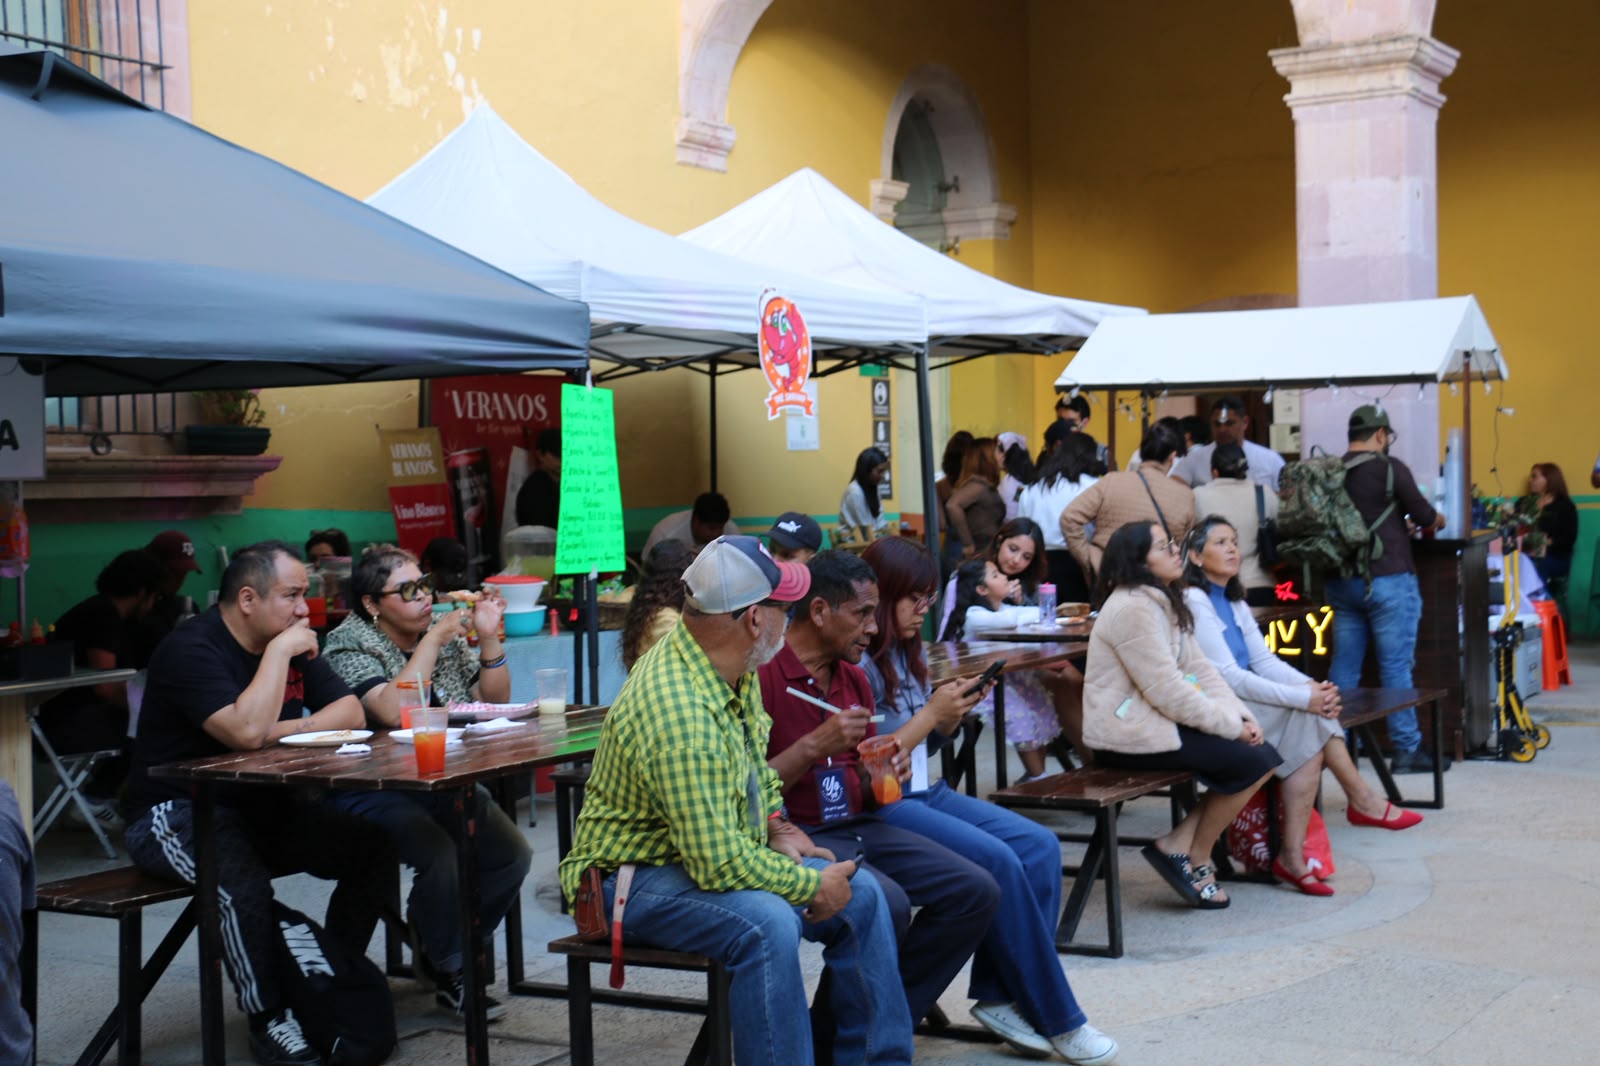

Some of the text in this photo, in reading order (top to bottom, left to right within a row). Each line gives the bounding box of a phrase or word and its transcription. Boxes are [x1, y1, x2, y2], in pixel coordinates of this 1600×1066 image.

[452, 390, 548, 421] VERANOS
[389, 442, 433, 459] VERANOS
[280, 921, 335, 977] NIKE
